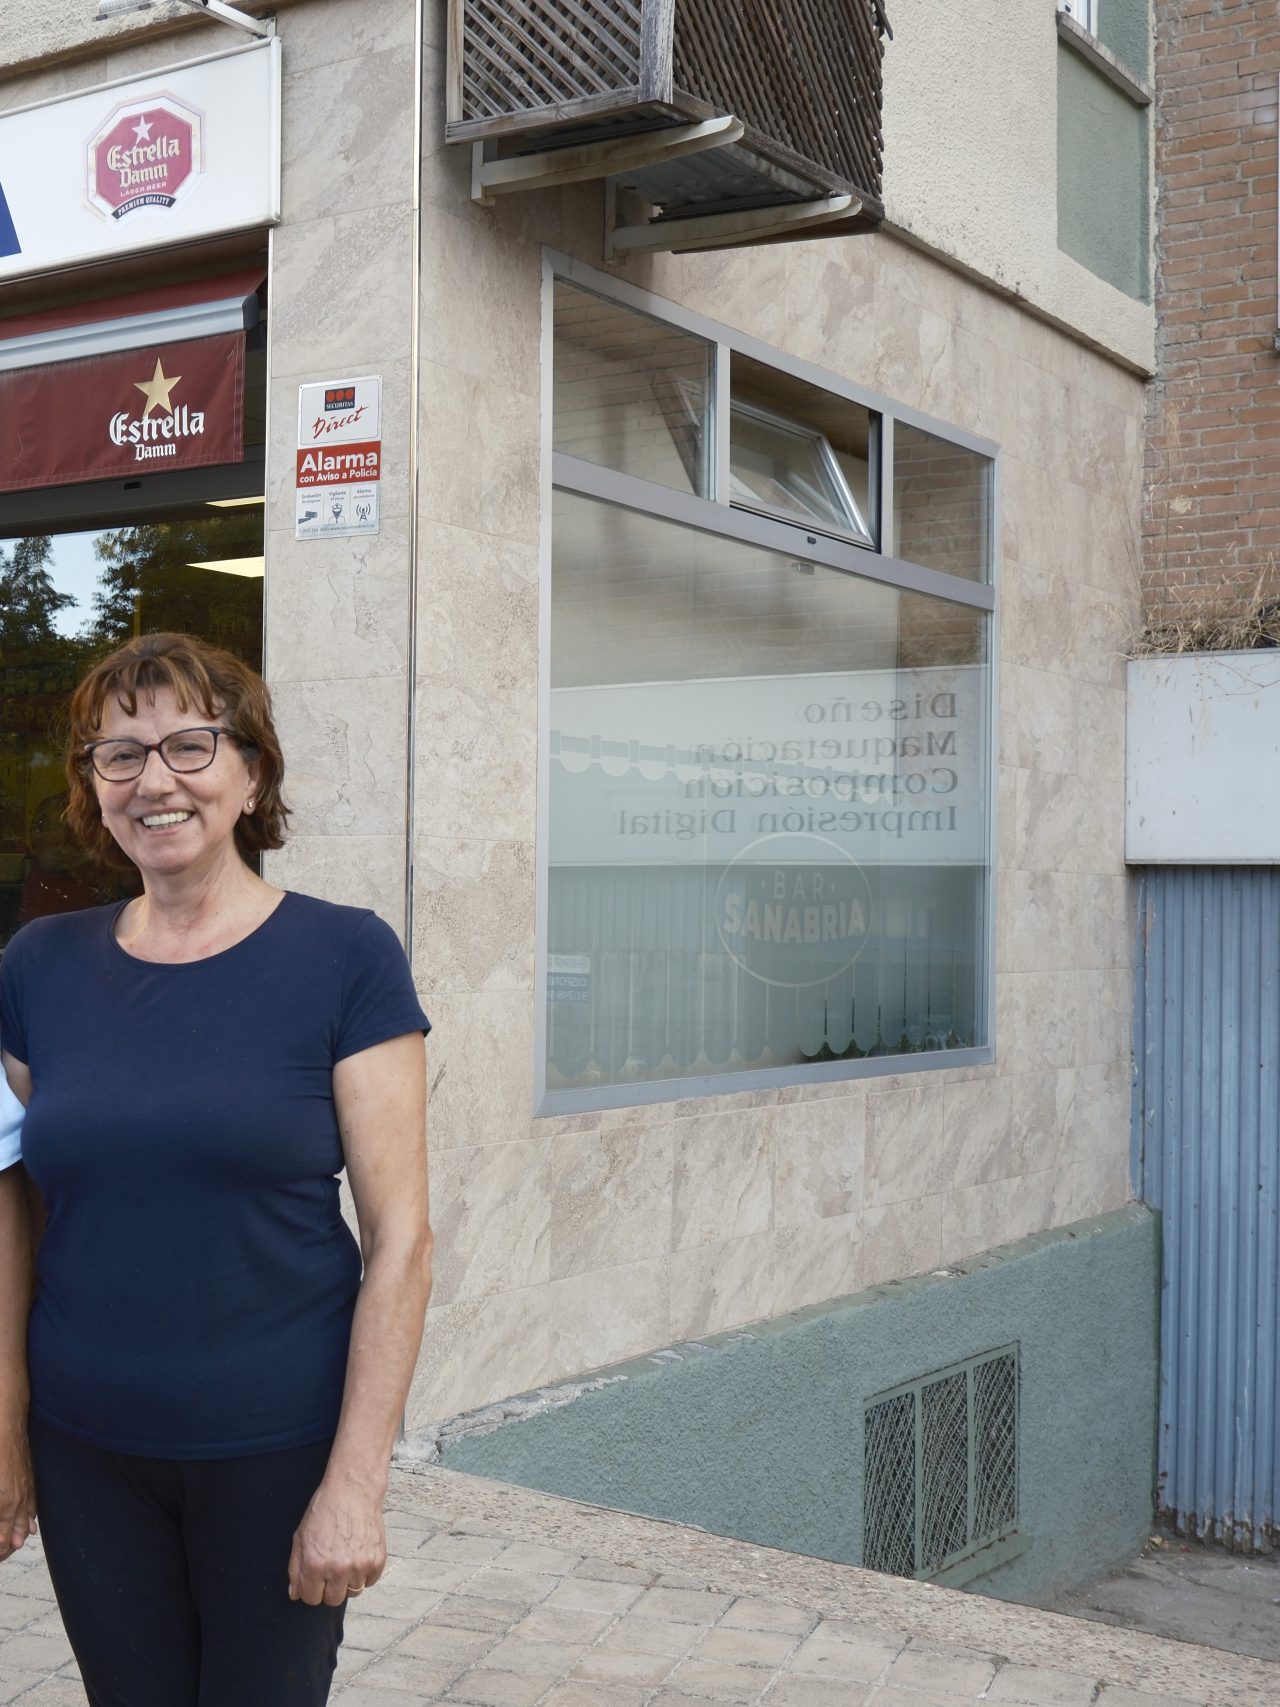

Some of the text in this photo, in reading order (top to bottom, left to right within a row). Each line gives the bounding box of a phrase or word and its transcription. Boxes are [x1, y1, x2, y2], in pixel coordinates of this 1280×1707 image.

[107, 135, 180, 172] Estrella
[119, 163, 168, 188] Damm
[120, 182, 167, 197] LAGER BEER
[117, 195, 170, 216] PREMIUM QUALITY
[326, 401, 354, 409] SECURITAS
[109, 404, 204, 446] Estrella
[312, 405, 369, 439] Direct
[134, 443, 176, 461] Damm
[300, 451, 378, 473] Alarma
[300, 475, 315, 483] con
[316, 472, 339, 482] Aviso
[349, 467, 377, 479] Policía
[774, 870, 824, 899] BAR
[723, 893, 866, 943] SANABRIA
